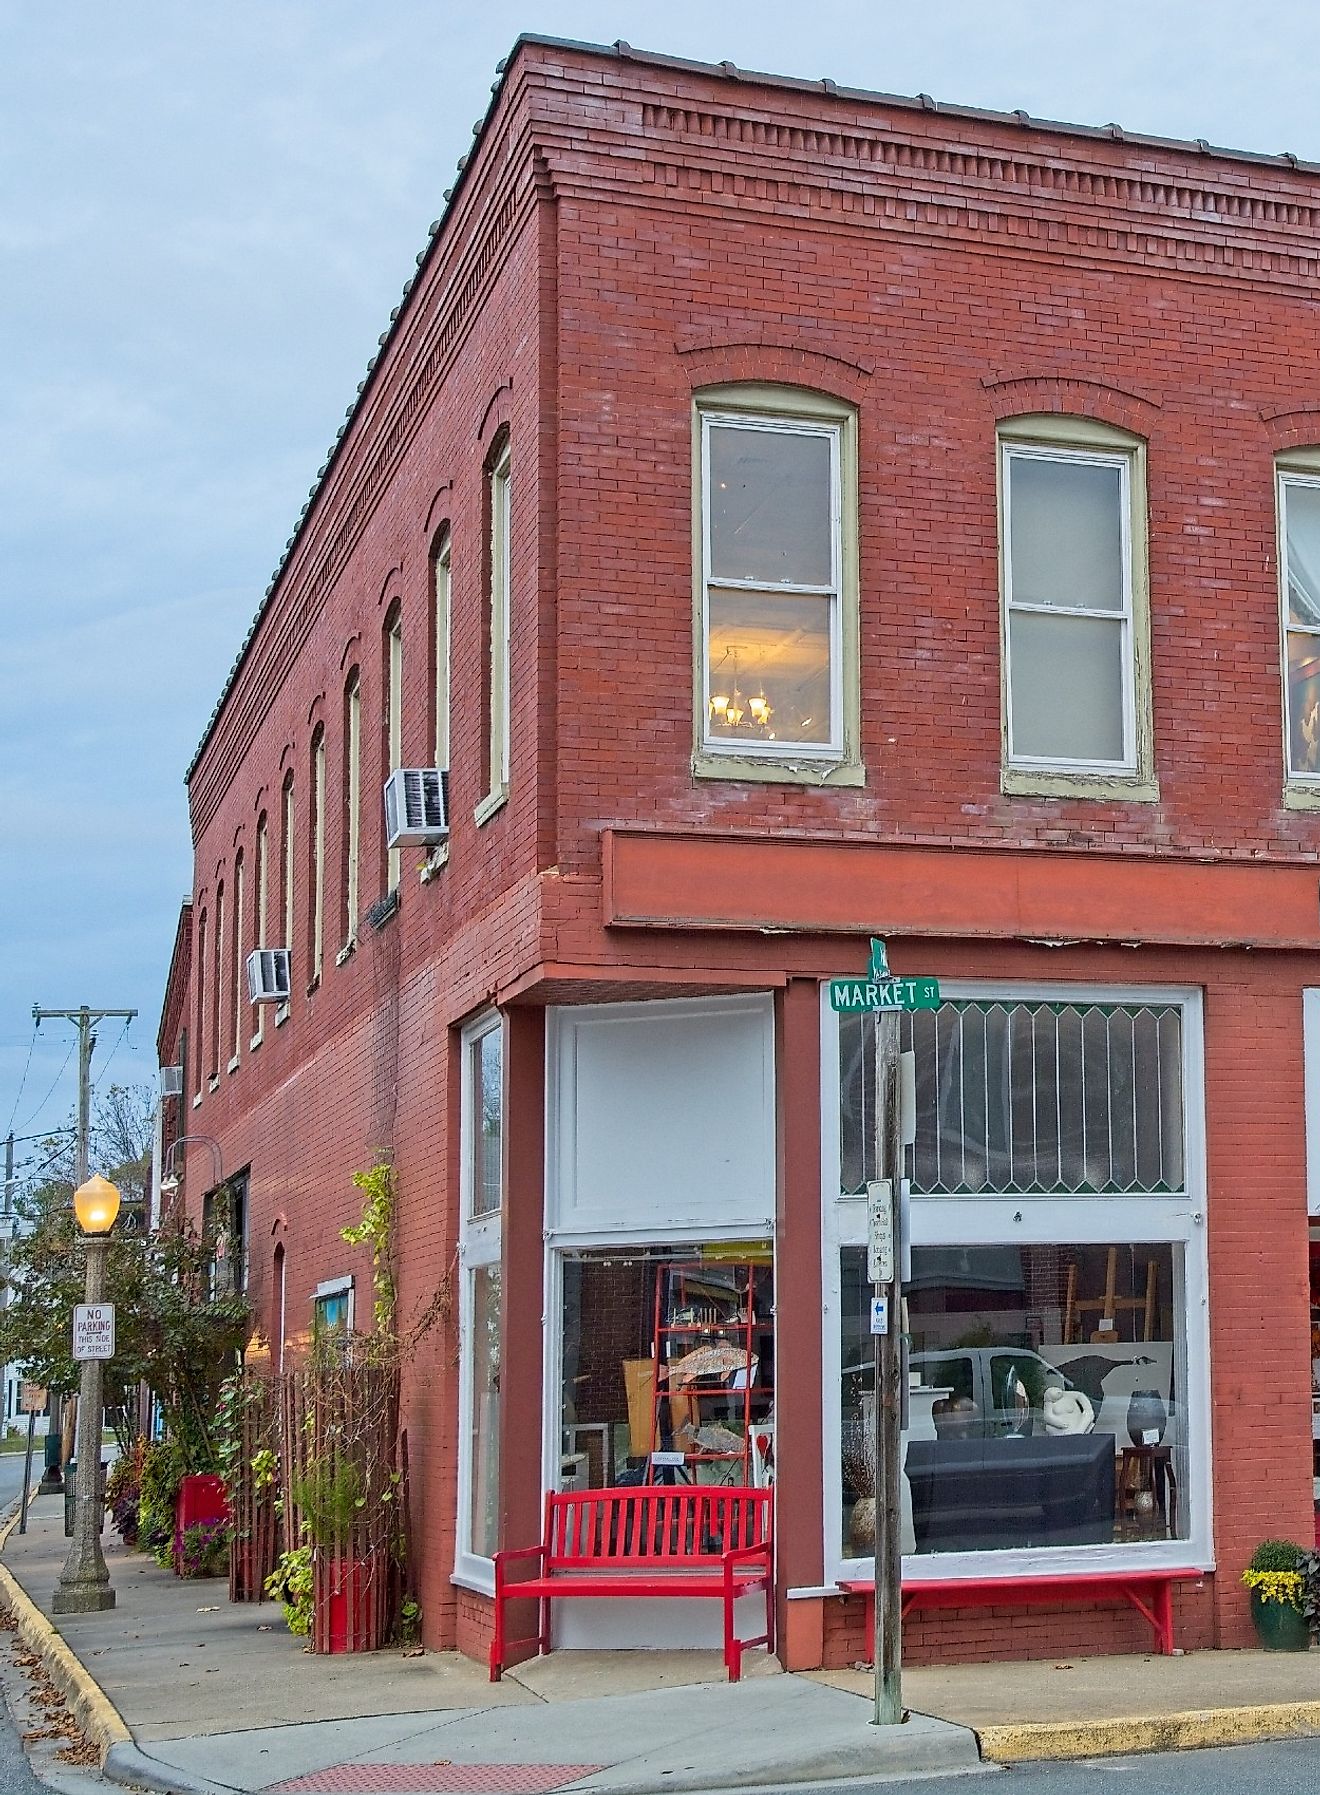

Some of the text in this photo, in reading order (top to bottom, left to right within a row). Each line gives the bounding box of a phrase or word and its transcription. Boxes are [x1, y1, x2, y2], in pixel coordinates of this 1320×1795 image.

[834, 982, 935, 1007] MARKET ST
[87, 1309, 102, 1320] NO
[77, 1320, 111, 1332] PARKING
[78, 1335, 110, 1343] THIS SIDE
[87, 1344, 111, 1353] STREET
